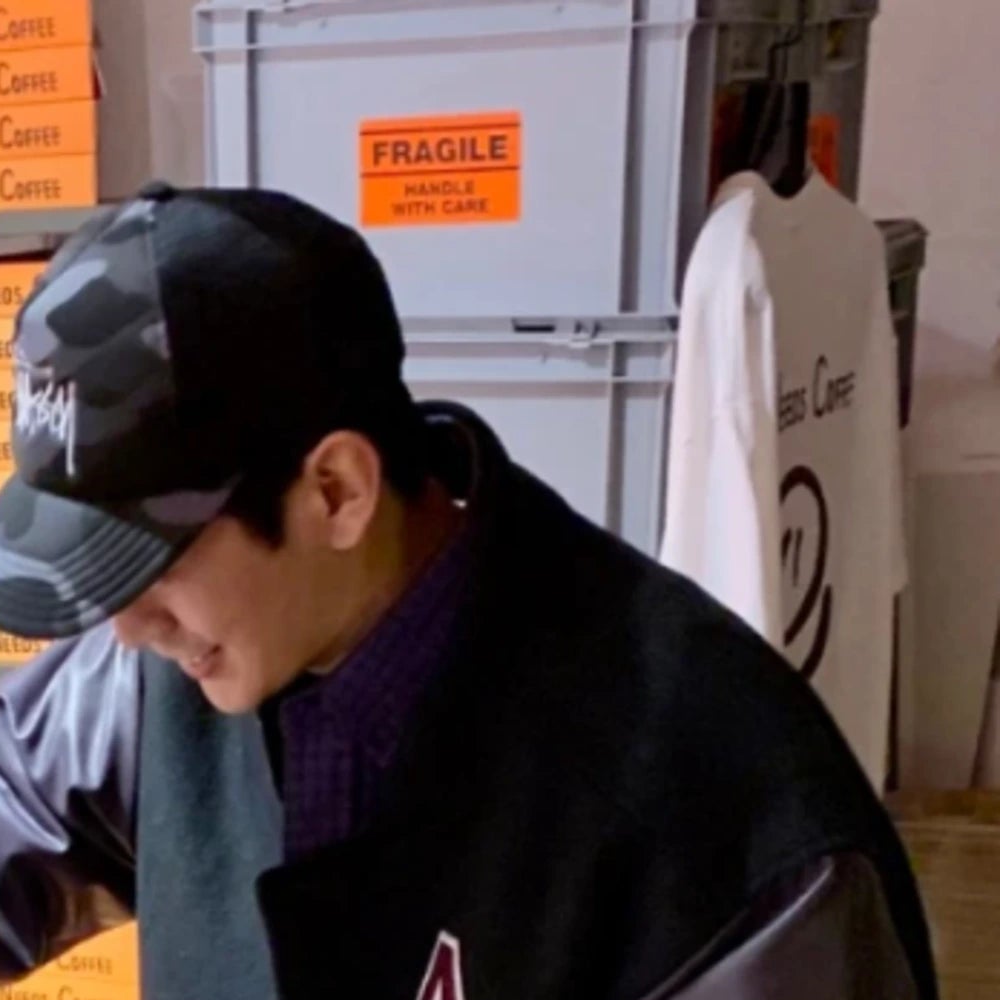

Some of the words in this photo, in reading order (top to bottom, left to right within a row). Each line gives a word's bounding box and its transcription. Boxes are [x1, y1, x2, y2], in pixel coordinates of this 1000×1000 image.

[372, 134, 508, 167] FRAGILE
[404, 180, 475, 198] HANDLE
[391, 201, 436, 217] WITH
[442, 198, 490, 215] CARE
